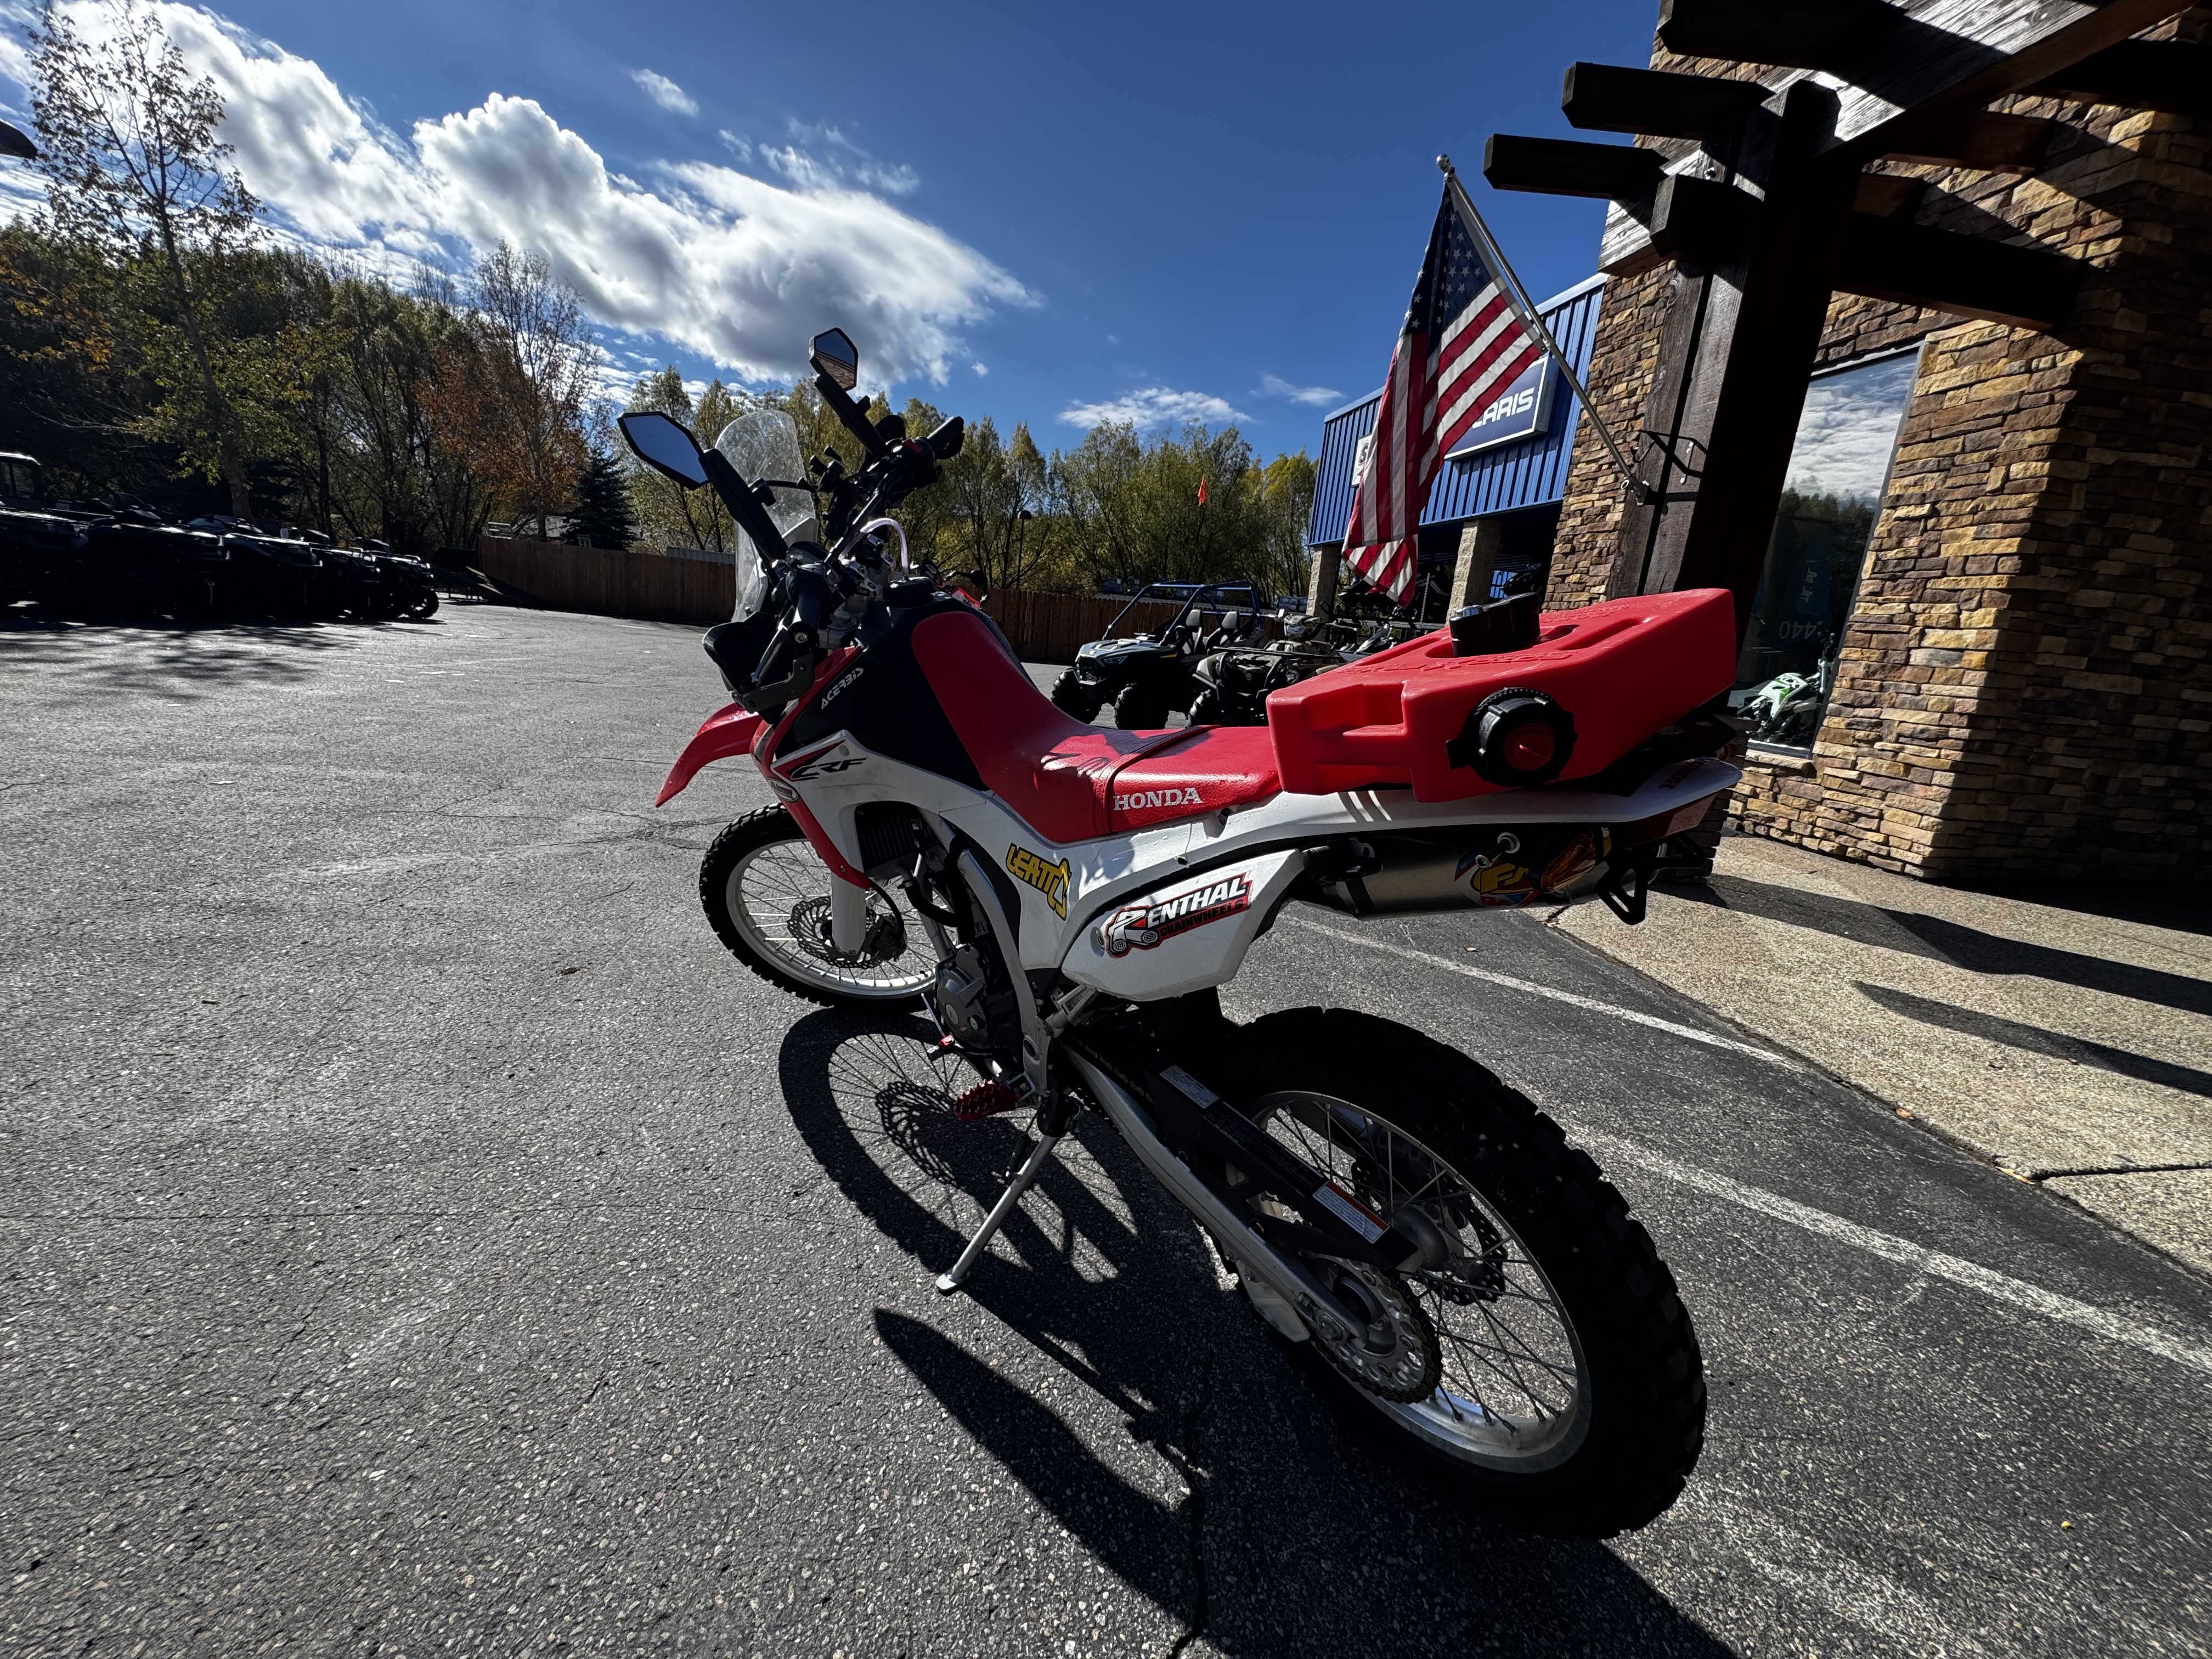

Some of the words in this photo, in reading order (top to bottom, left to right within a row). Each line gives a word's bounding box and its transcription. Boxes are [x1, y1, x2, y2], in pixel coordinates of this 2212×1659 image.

[1778, 620, 1818, 640] 440
[791, 757, 867, 779] CRF
[1113, 787, 1203, 811] HONDA
[1107, 877, 1247, 952] RENTHAL
[1159, 898, 1244, 937] CHAINWHEELS
